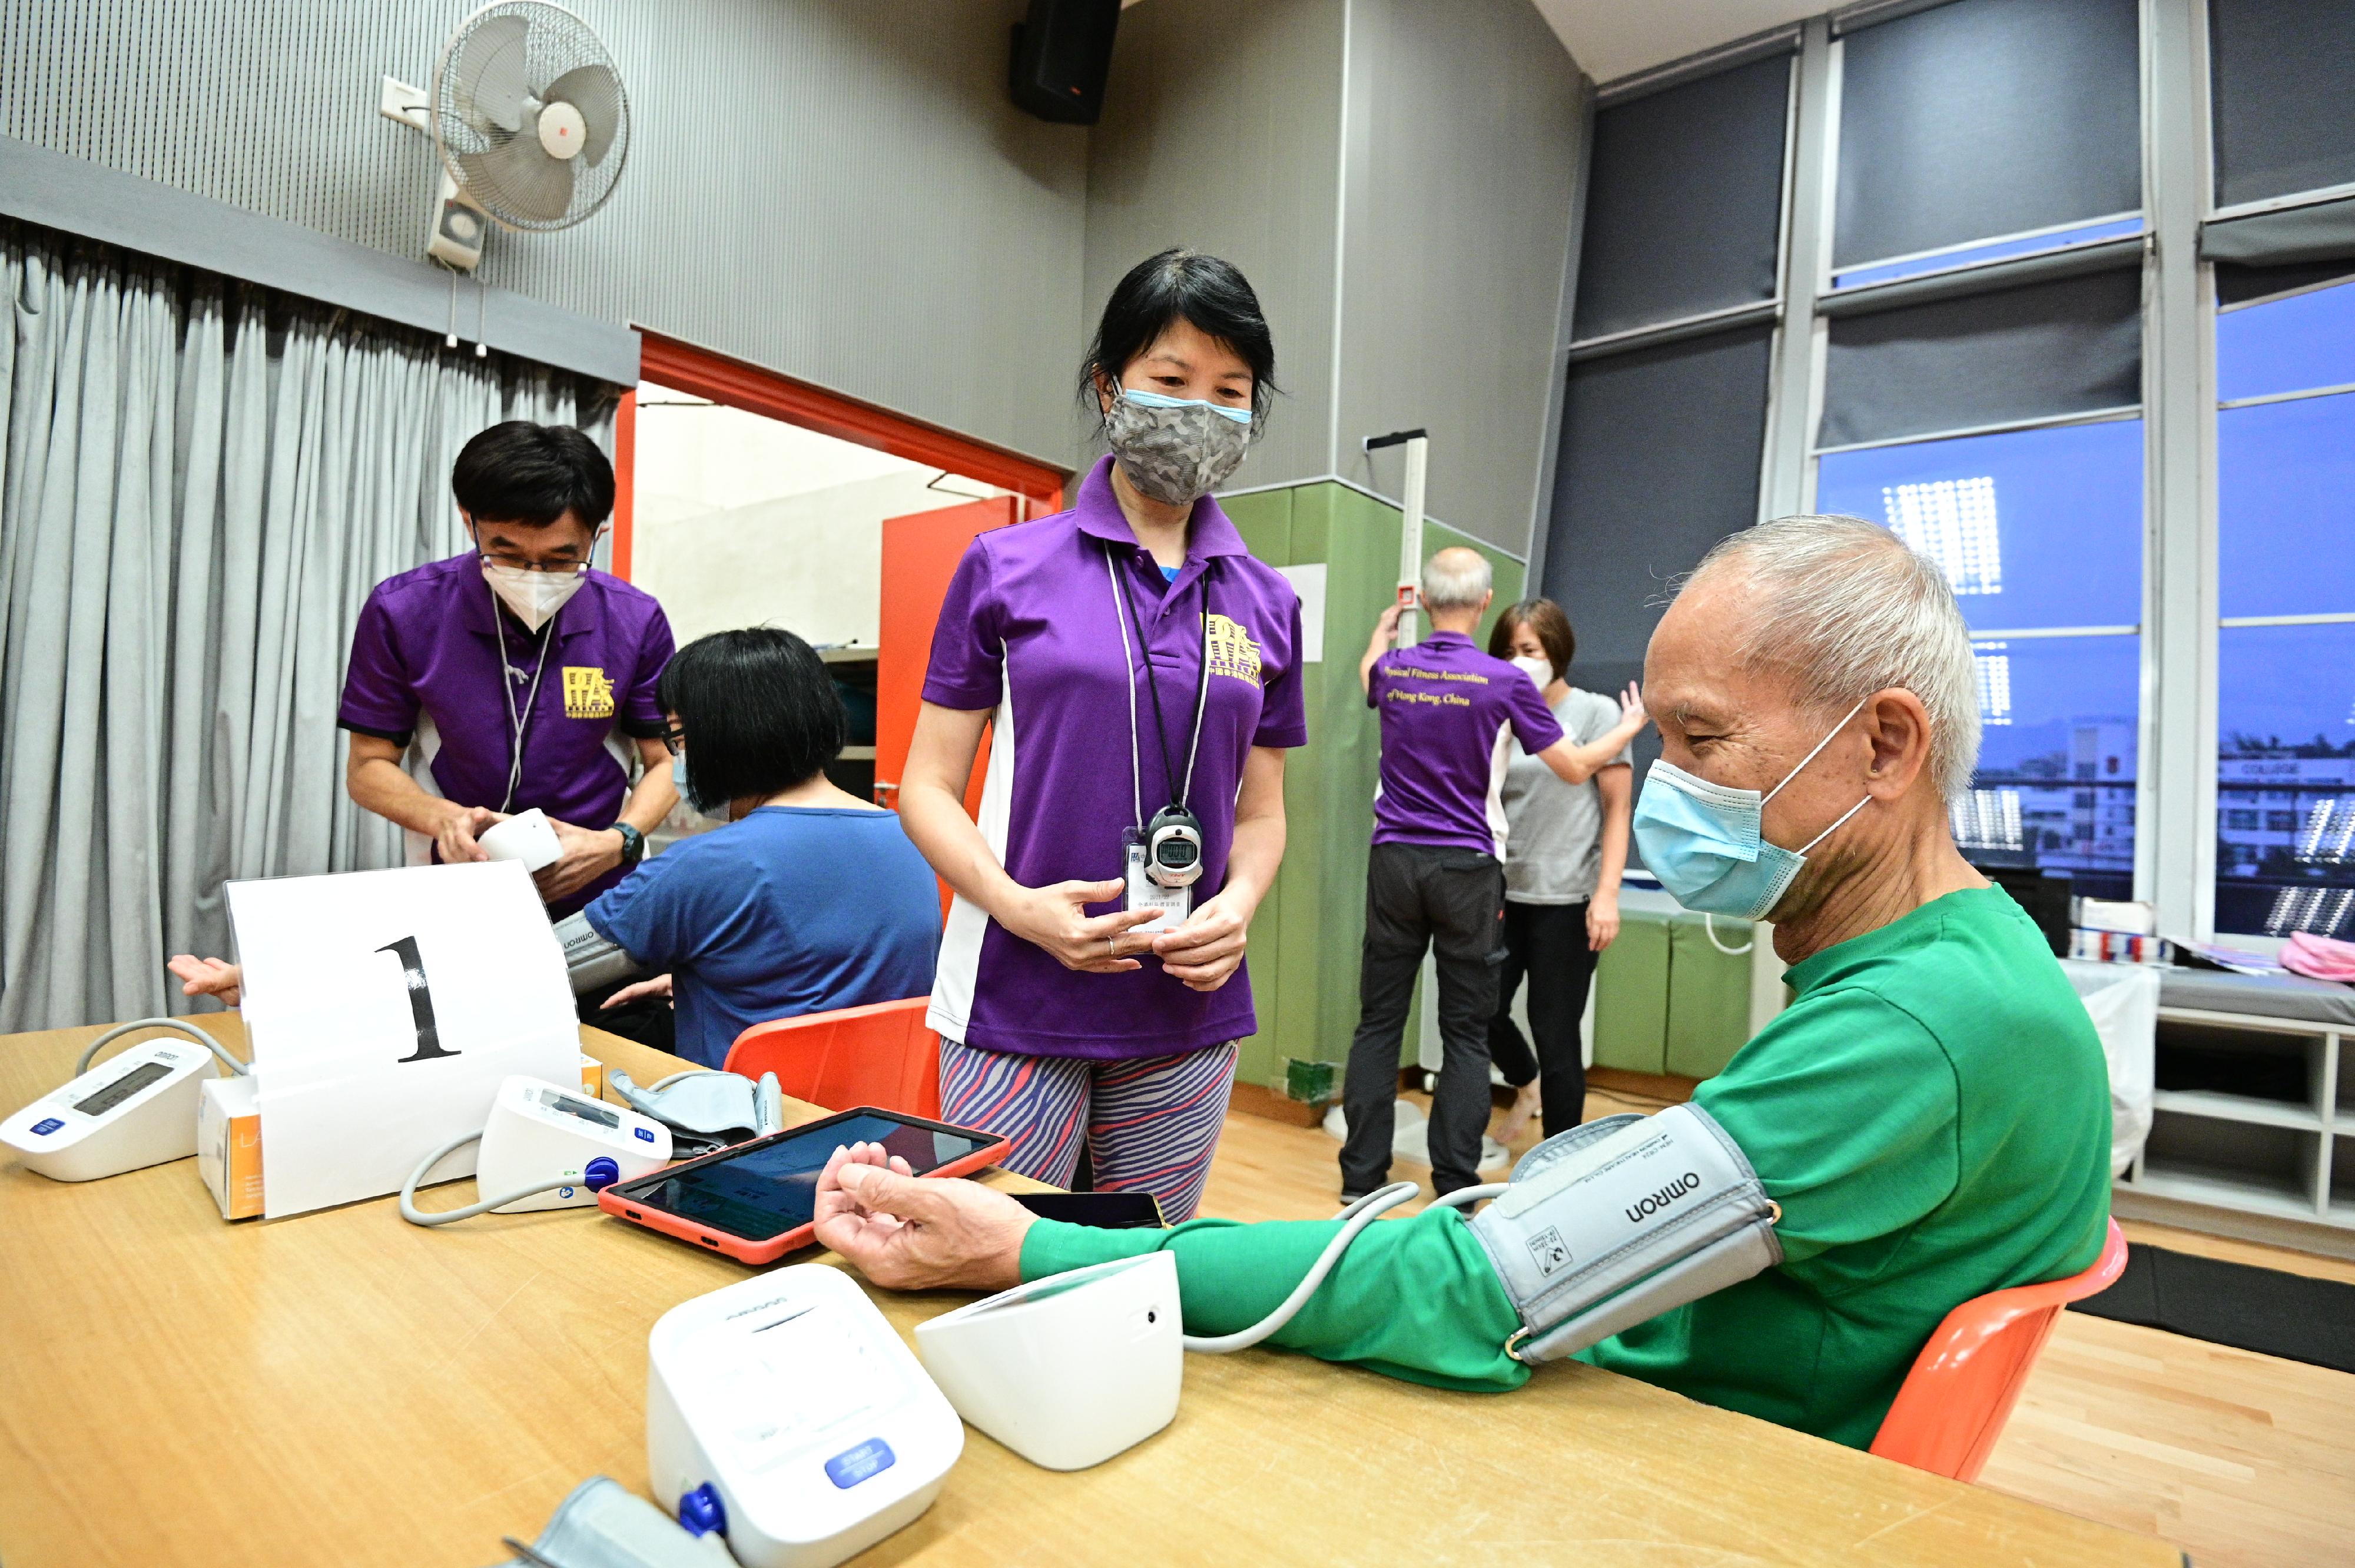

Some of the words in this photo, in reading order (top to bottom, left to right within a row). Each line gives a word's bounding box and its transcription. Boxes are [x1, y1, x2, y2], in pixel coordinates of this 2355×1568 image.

[1411, 668, 1439, 680] Fitness
[1440, 670, 1488, 685] Association
[1398, 690, 1417, 705] Hong
[1418, 692, 1442, 706] Kong,
[1443, 693, 1470, 706] China
[374, 935, 462, 1064] 1
